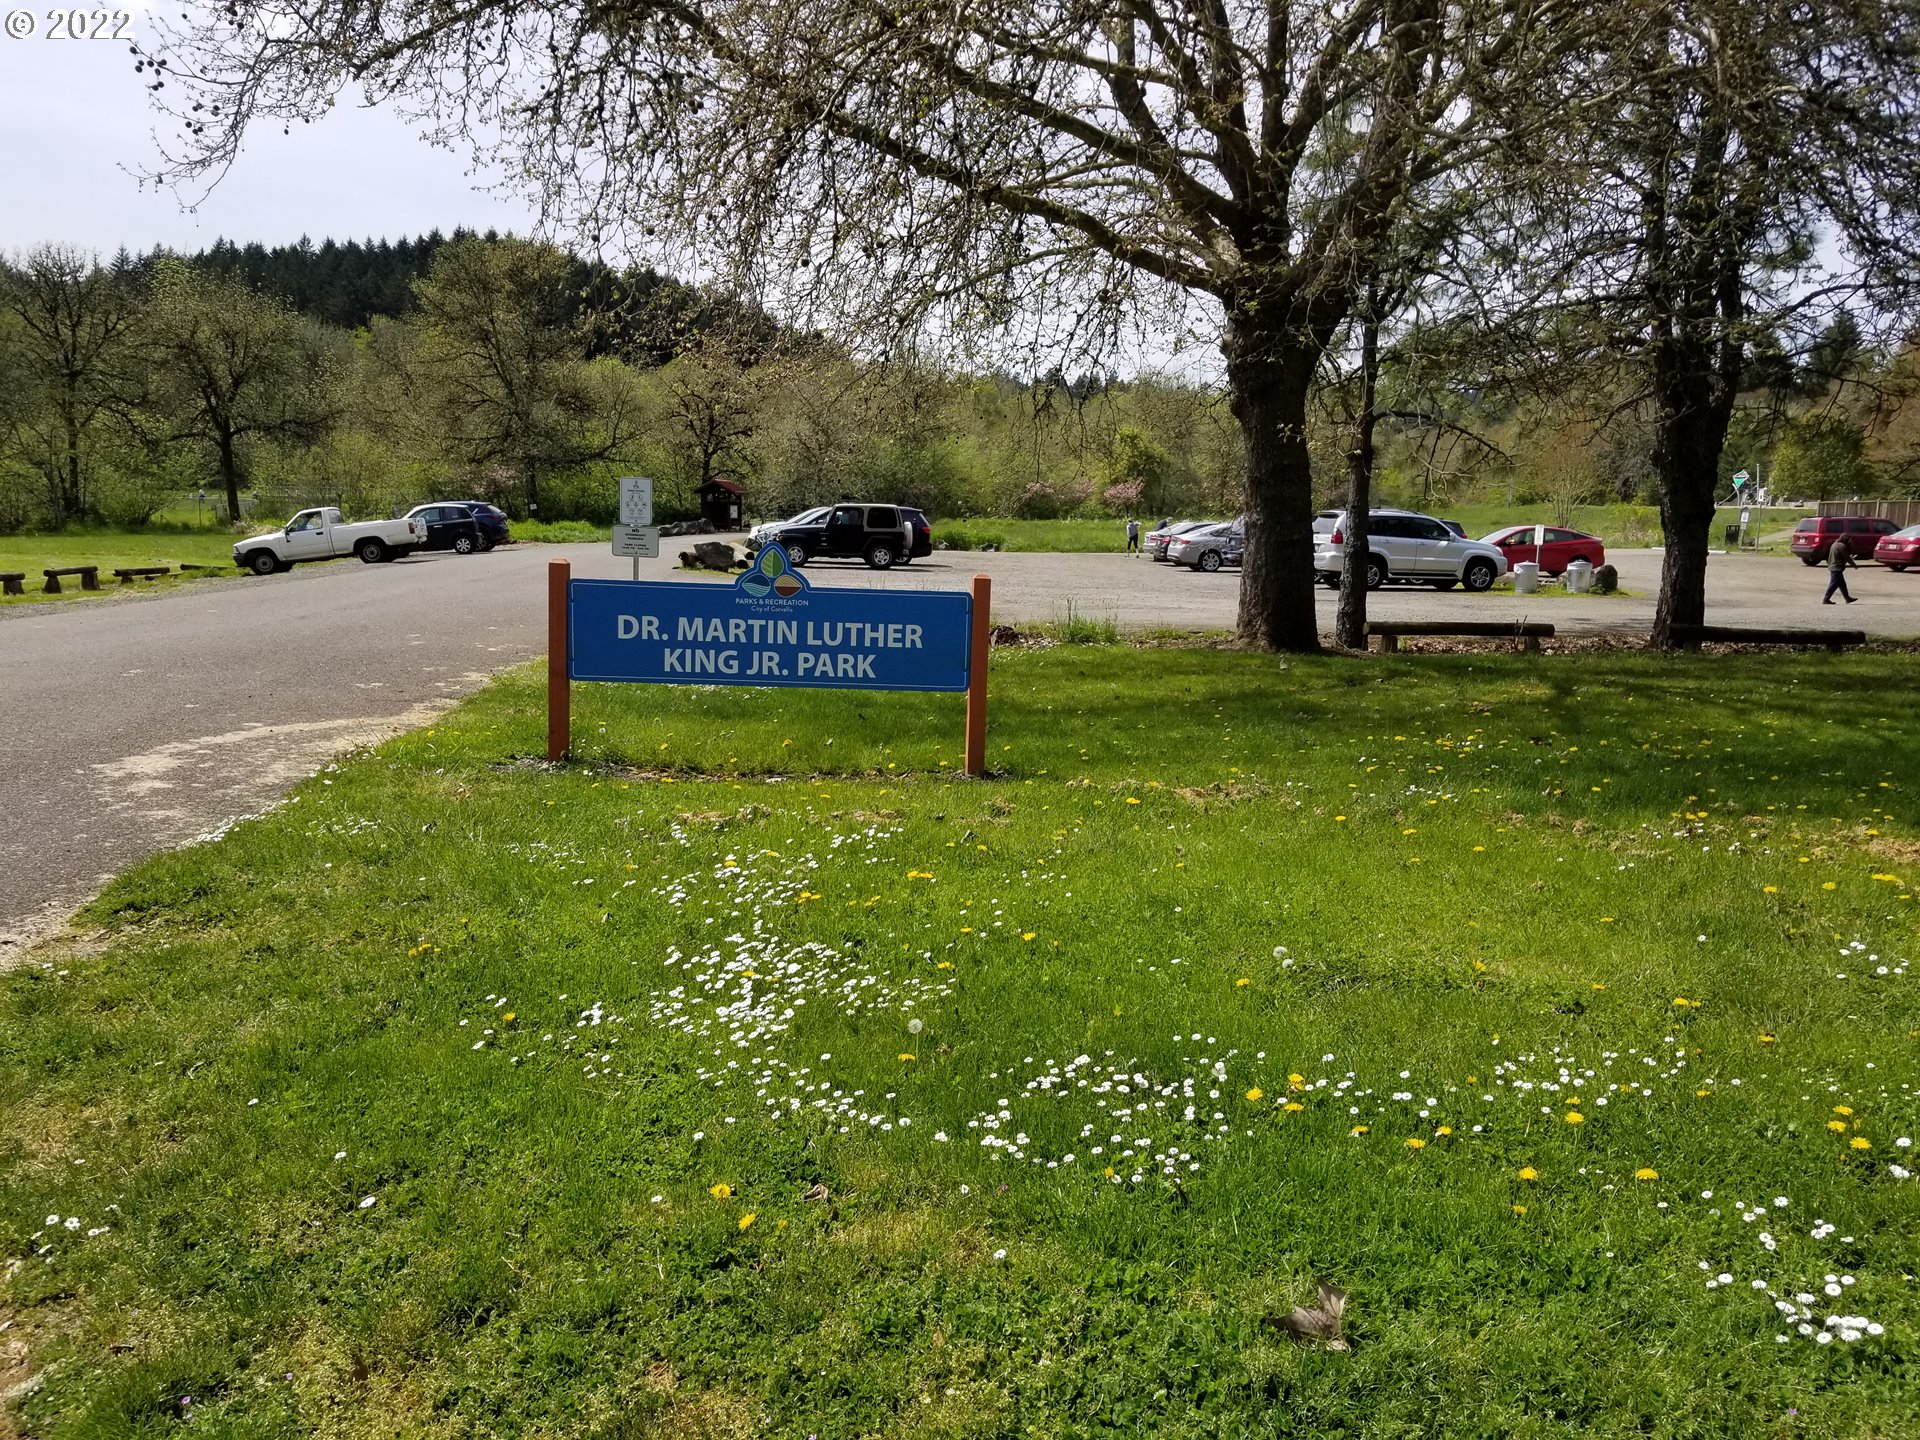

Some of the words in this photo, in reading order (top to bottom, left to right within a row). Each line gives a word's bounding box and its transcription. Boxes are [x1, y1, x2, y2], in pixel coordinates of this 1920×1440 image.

[751, 605, 763, 613] City
[617, 614, 669, 641] DR.
[677, 616, 797, 645] MARTIN
[807, 621, 923, 649] LUTHER
[663, 648, 739, 674] KING
[746, 651, 789, 676] JR.
[797, 652, 877, 678] PARK
